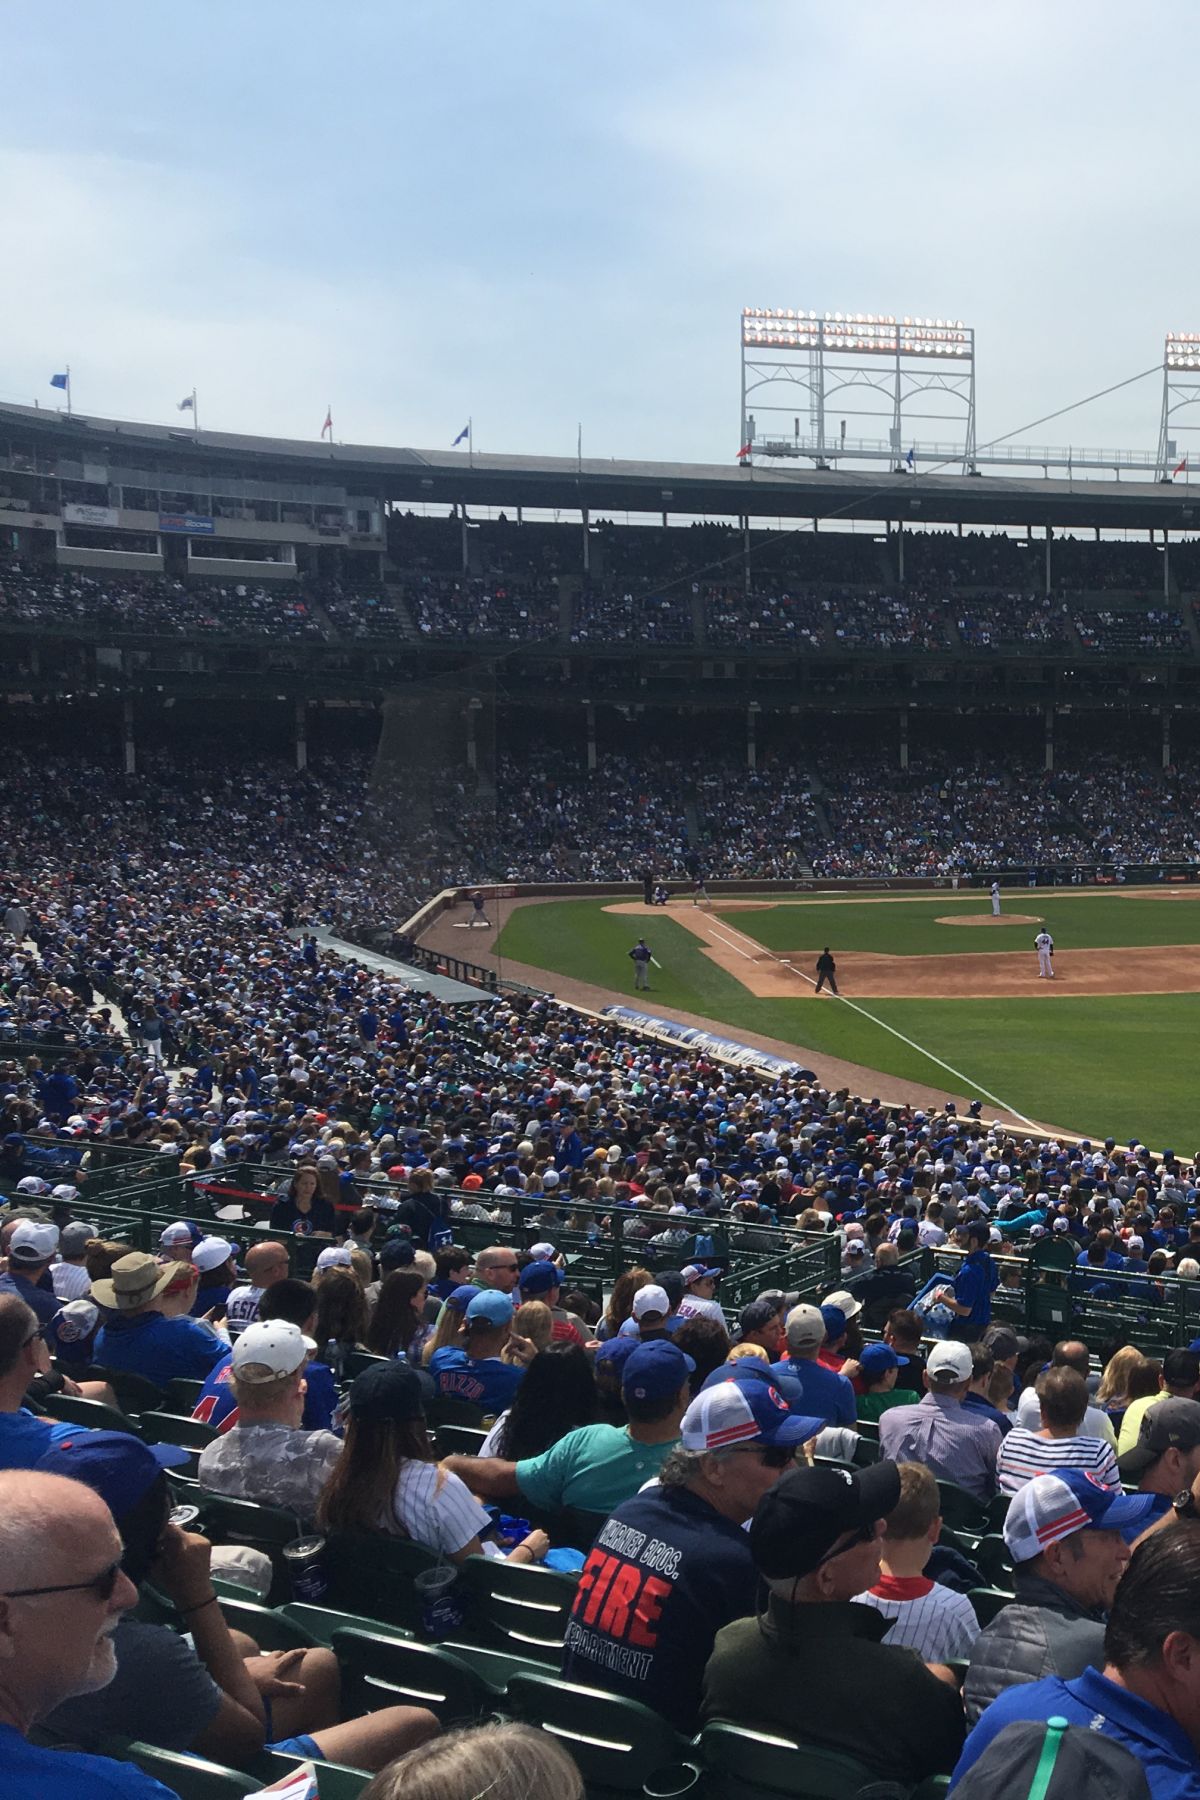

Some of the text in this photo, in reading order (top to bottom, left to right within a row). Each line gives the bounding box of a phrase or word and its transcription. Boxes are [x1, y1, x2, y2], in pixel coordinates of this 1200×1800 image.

[440, 1372, 485, 1399] RIZZO
[598, 1519, 683, 1580] WARNER BROS.
[571, 1548, 673, 1648] FIRE
